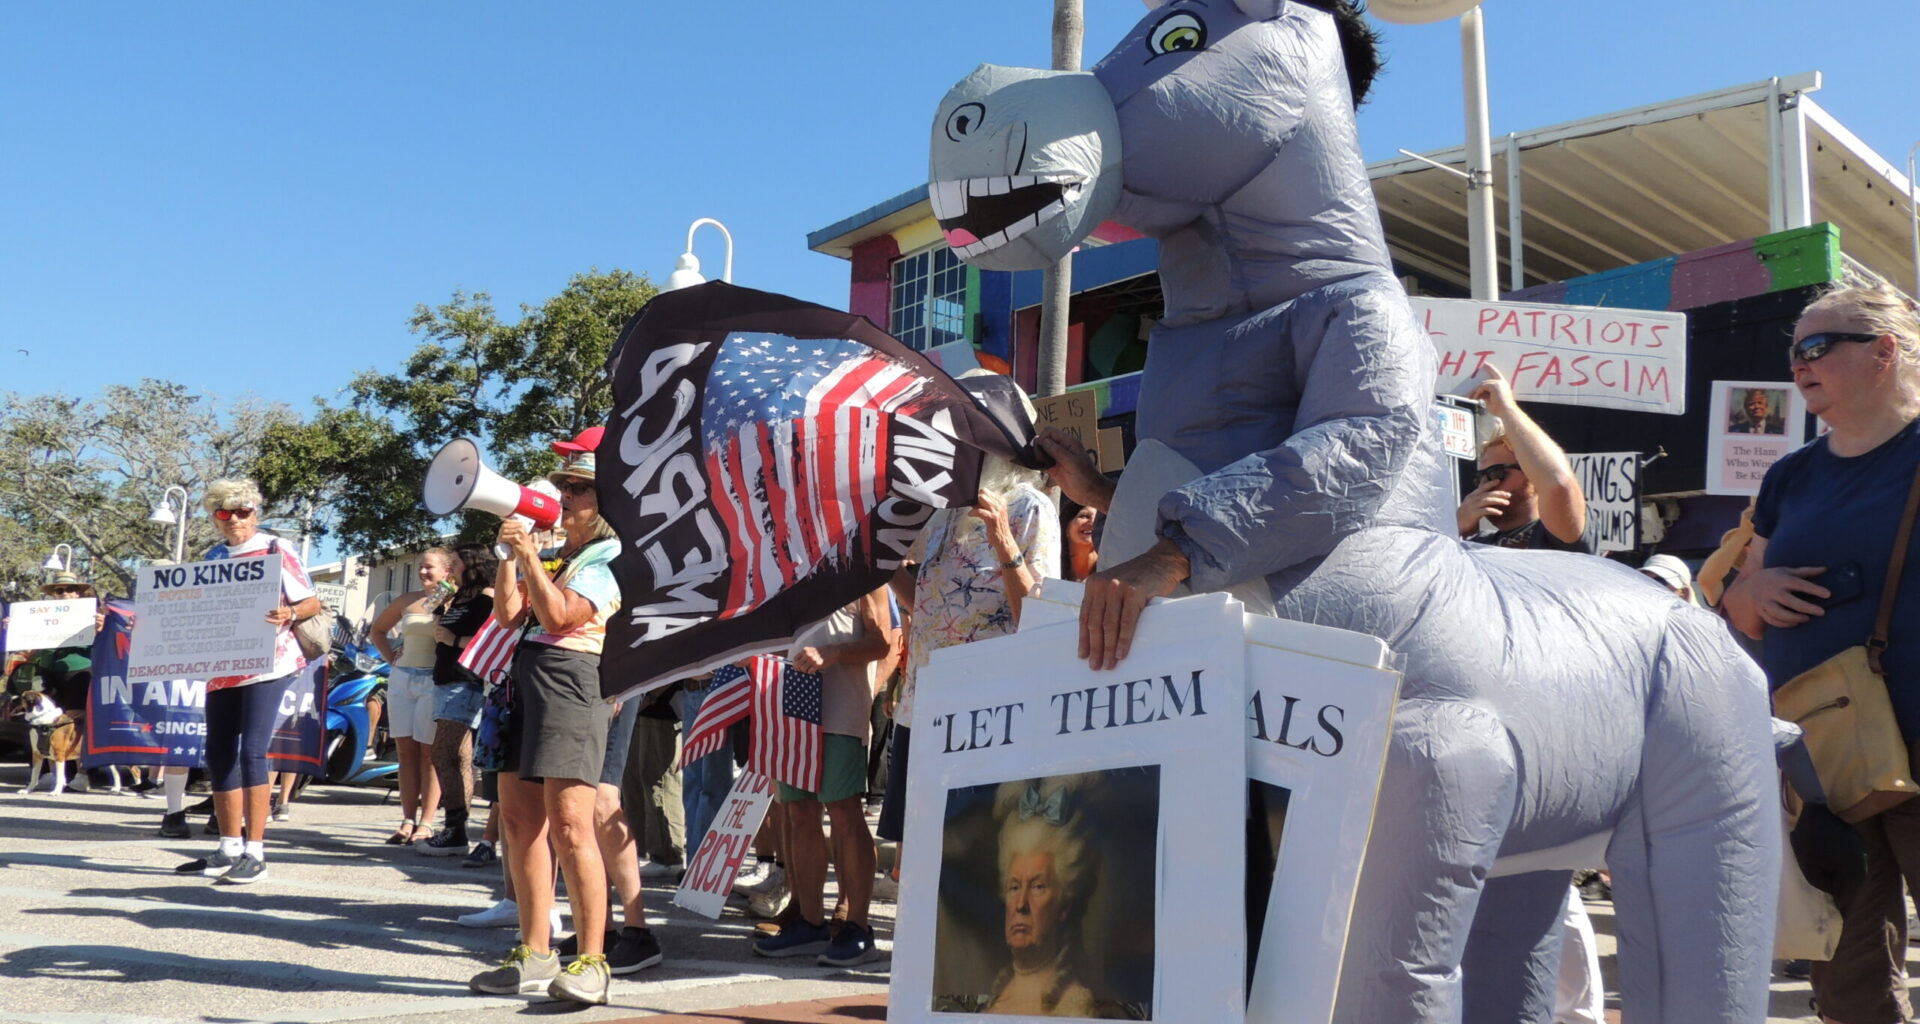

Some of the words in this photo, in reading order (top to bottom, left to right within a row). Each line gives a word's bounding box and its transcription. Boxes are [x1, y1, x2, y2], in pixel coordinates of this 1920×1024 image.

[1477, 308, 1669, 348] PATRIOTS
[1510, 352, 1670, 403] FASCIM
[1067, 398, 1084, 417] IS
[1733, 446, 1751, 455] The
[1754, 447, 1777, 456] Ham
[1726, 458, 1749, 467] Who
[1735, 471, 1748, 480] Be
[153, 567, 186, 589] NO
[193, 560, 265, 586] KINGS
[157, 588, 202, 602] POTUS
[317, 586, 345, 597] SPEED
[29, 606, 50, 614] SAY
[55, 605, 70, 613] NO
[148, 604, 166, 616] NO
[191, 597, 257, 612] MILITARY
[160, 612, 240, 628] OCCUPYING
[128, 661, 211, 678] DEMOCRACY
[212, 660, 230, 672] AT
[232, 657, 270, 671] RISK!
[101, 675, 133, 706] IN
[1051, 669, 1208, 736] THEM
[155, 721, 207, 736] SINCE
[1246, 689, 1344, 757] ALS
[722, 798, 754, 829] THE
[681, 829, 752, 897] RICH
